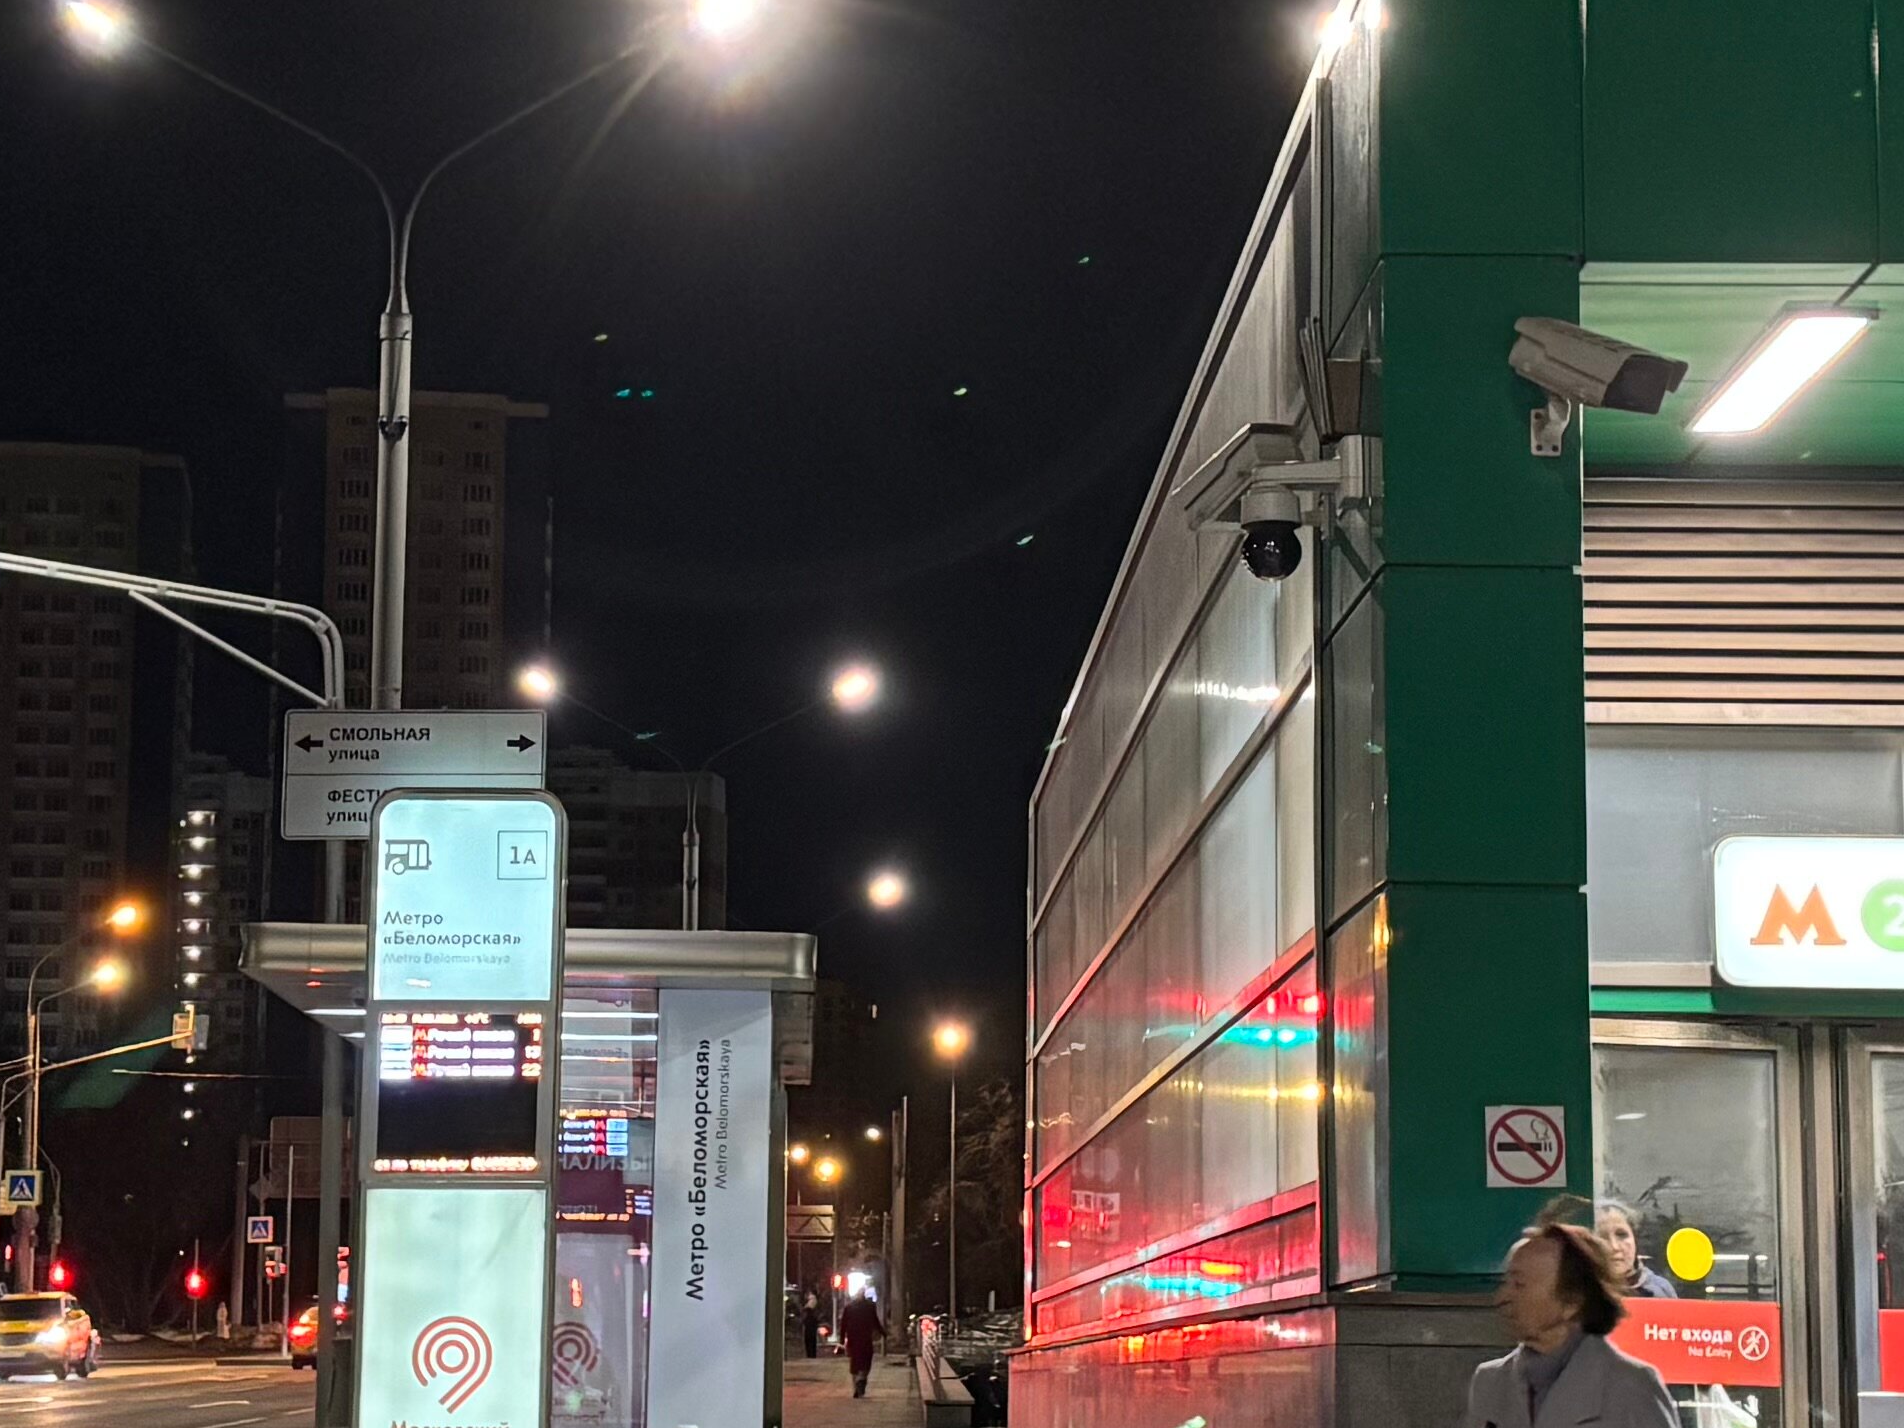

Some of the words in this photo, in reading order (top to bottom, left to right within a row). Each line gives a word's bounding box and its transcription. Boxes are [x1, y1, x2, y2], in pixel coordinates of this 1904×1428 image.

[329, 728, 431, 741] СМОЛЬНАЯ
[328, 749, 380, 764] улица
[327, 789, 381, 803] ФЕСТ
[326, 811, 368, 825] улиц
[383, 910, 444, 928] Метро
[383, 930, 522, 948] «Беломорская»
[715, 1038, 733, 1140] Belomorskaya
[688, 1038, 712, 1216] «Беломорская»
[714, 1144, 728, 1190] Metro
[685, 1222, 709, 1301] Метро
[1643, 1324, 1678, 1340] Нет
[1681, 1328, 1733, 1344] входа
